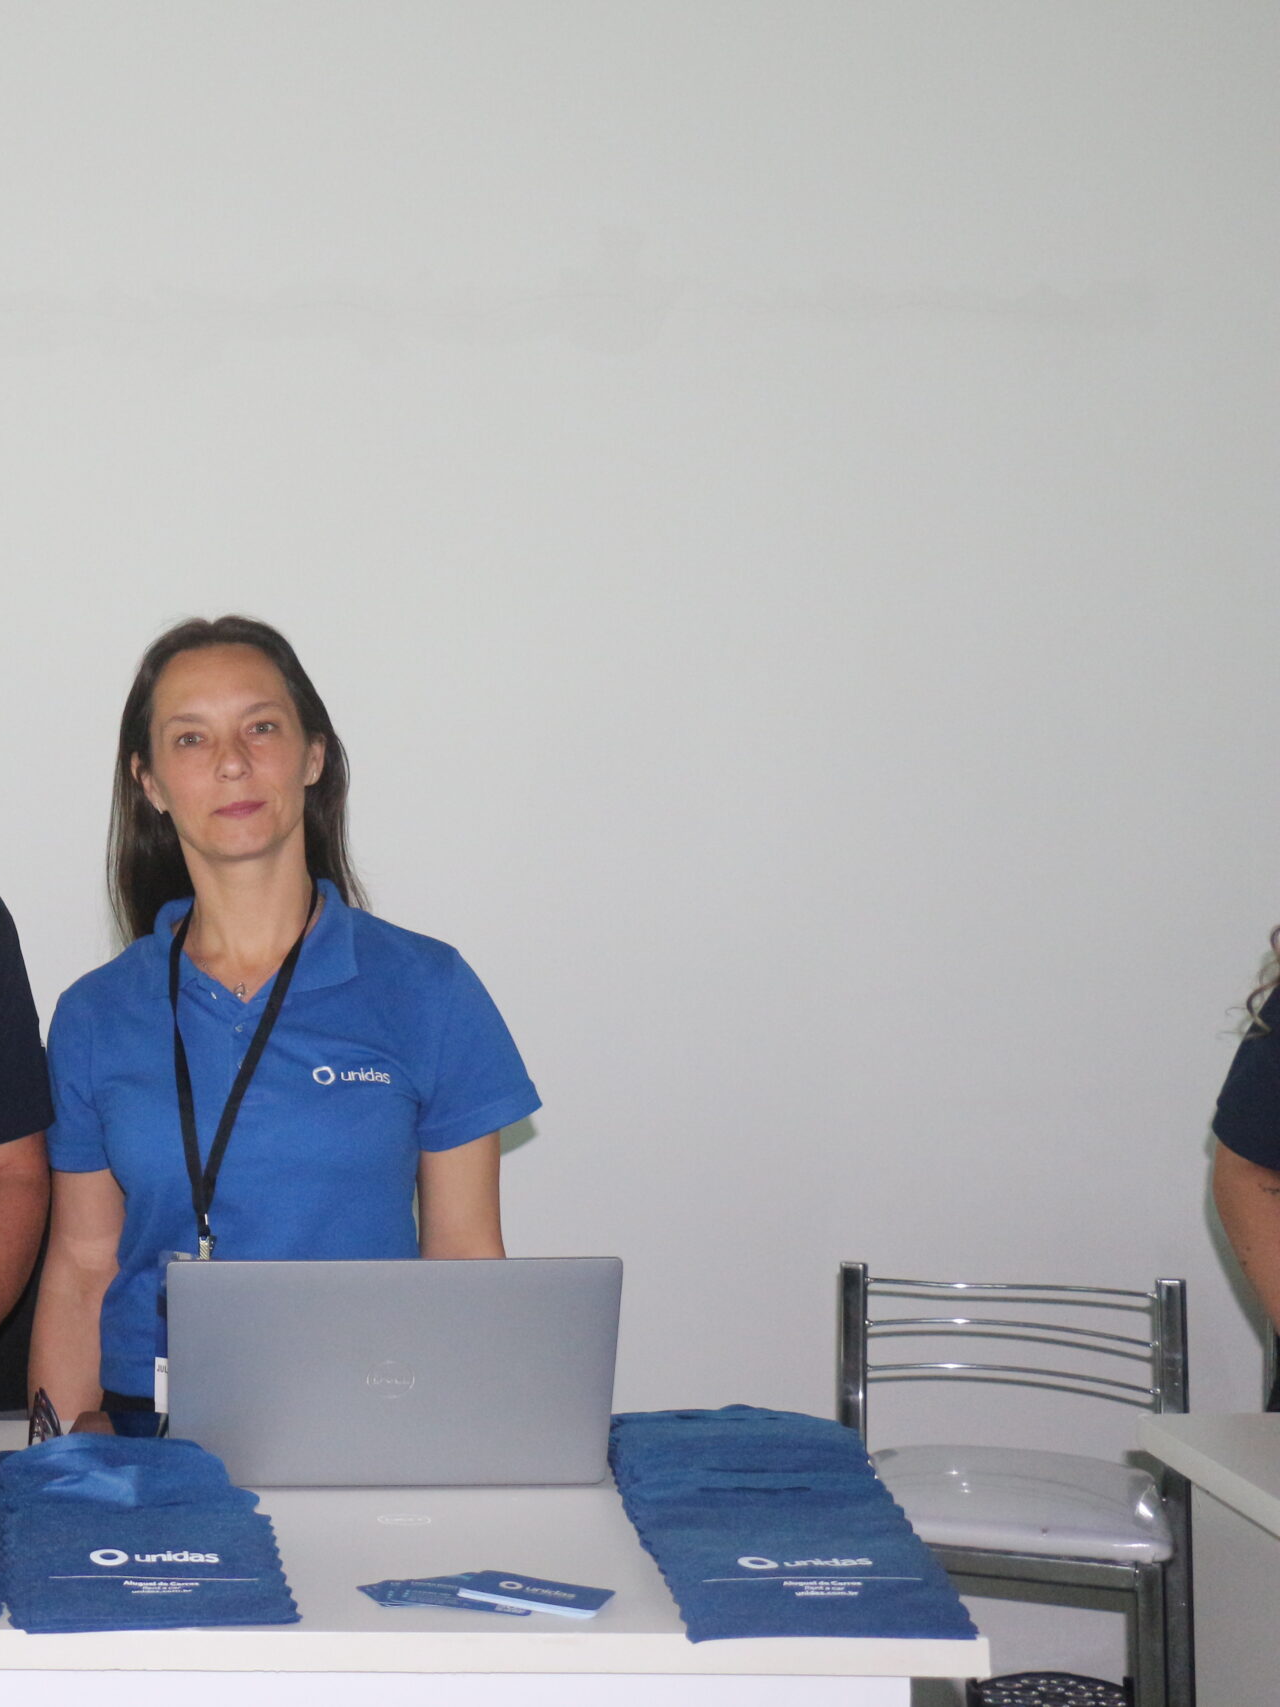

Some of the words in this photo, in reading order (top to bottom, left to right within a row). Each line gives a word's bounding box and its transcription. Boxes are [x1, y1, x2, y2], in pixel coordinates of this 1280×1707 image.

[340, 1067, 391, 1085] unidas
[133, 1550, 220, 1564] unidas
[783, 1557, 873, 1567] unidas
[524, 1586, 576, 1600] unidas
